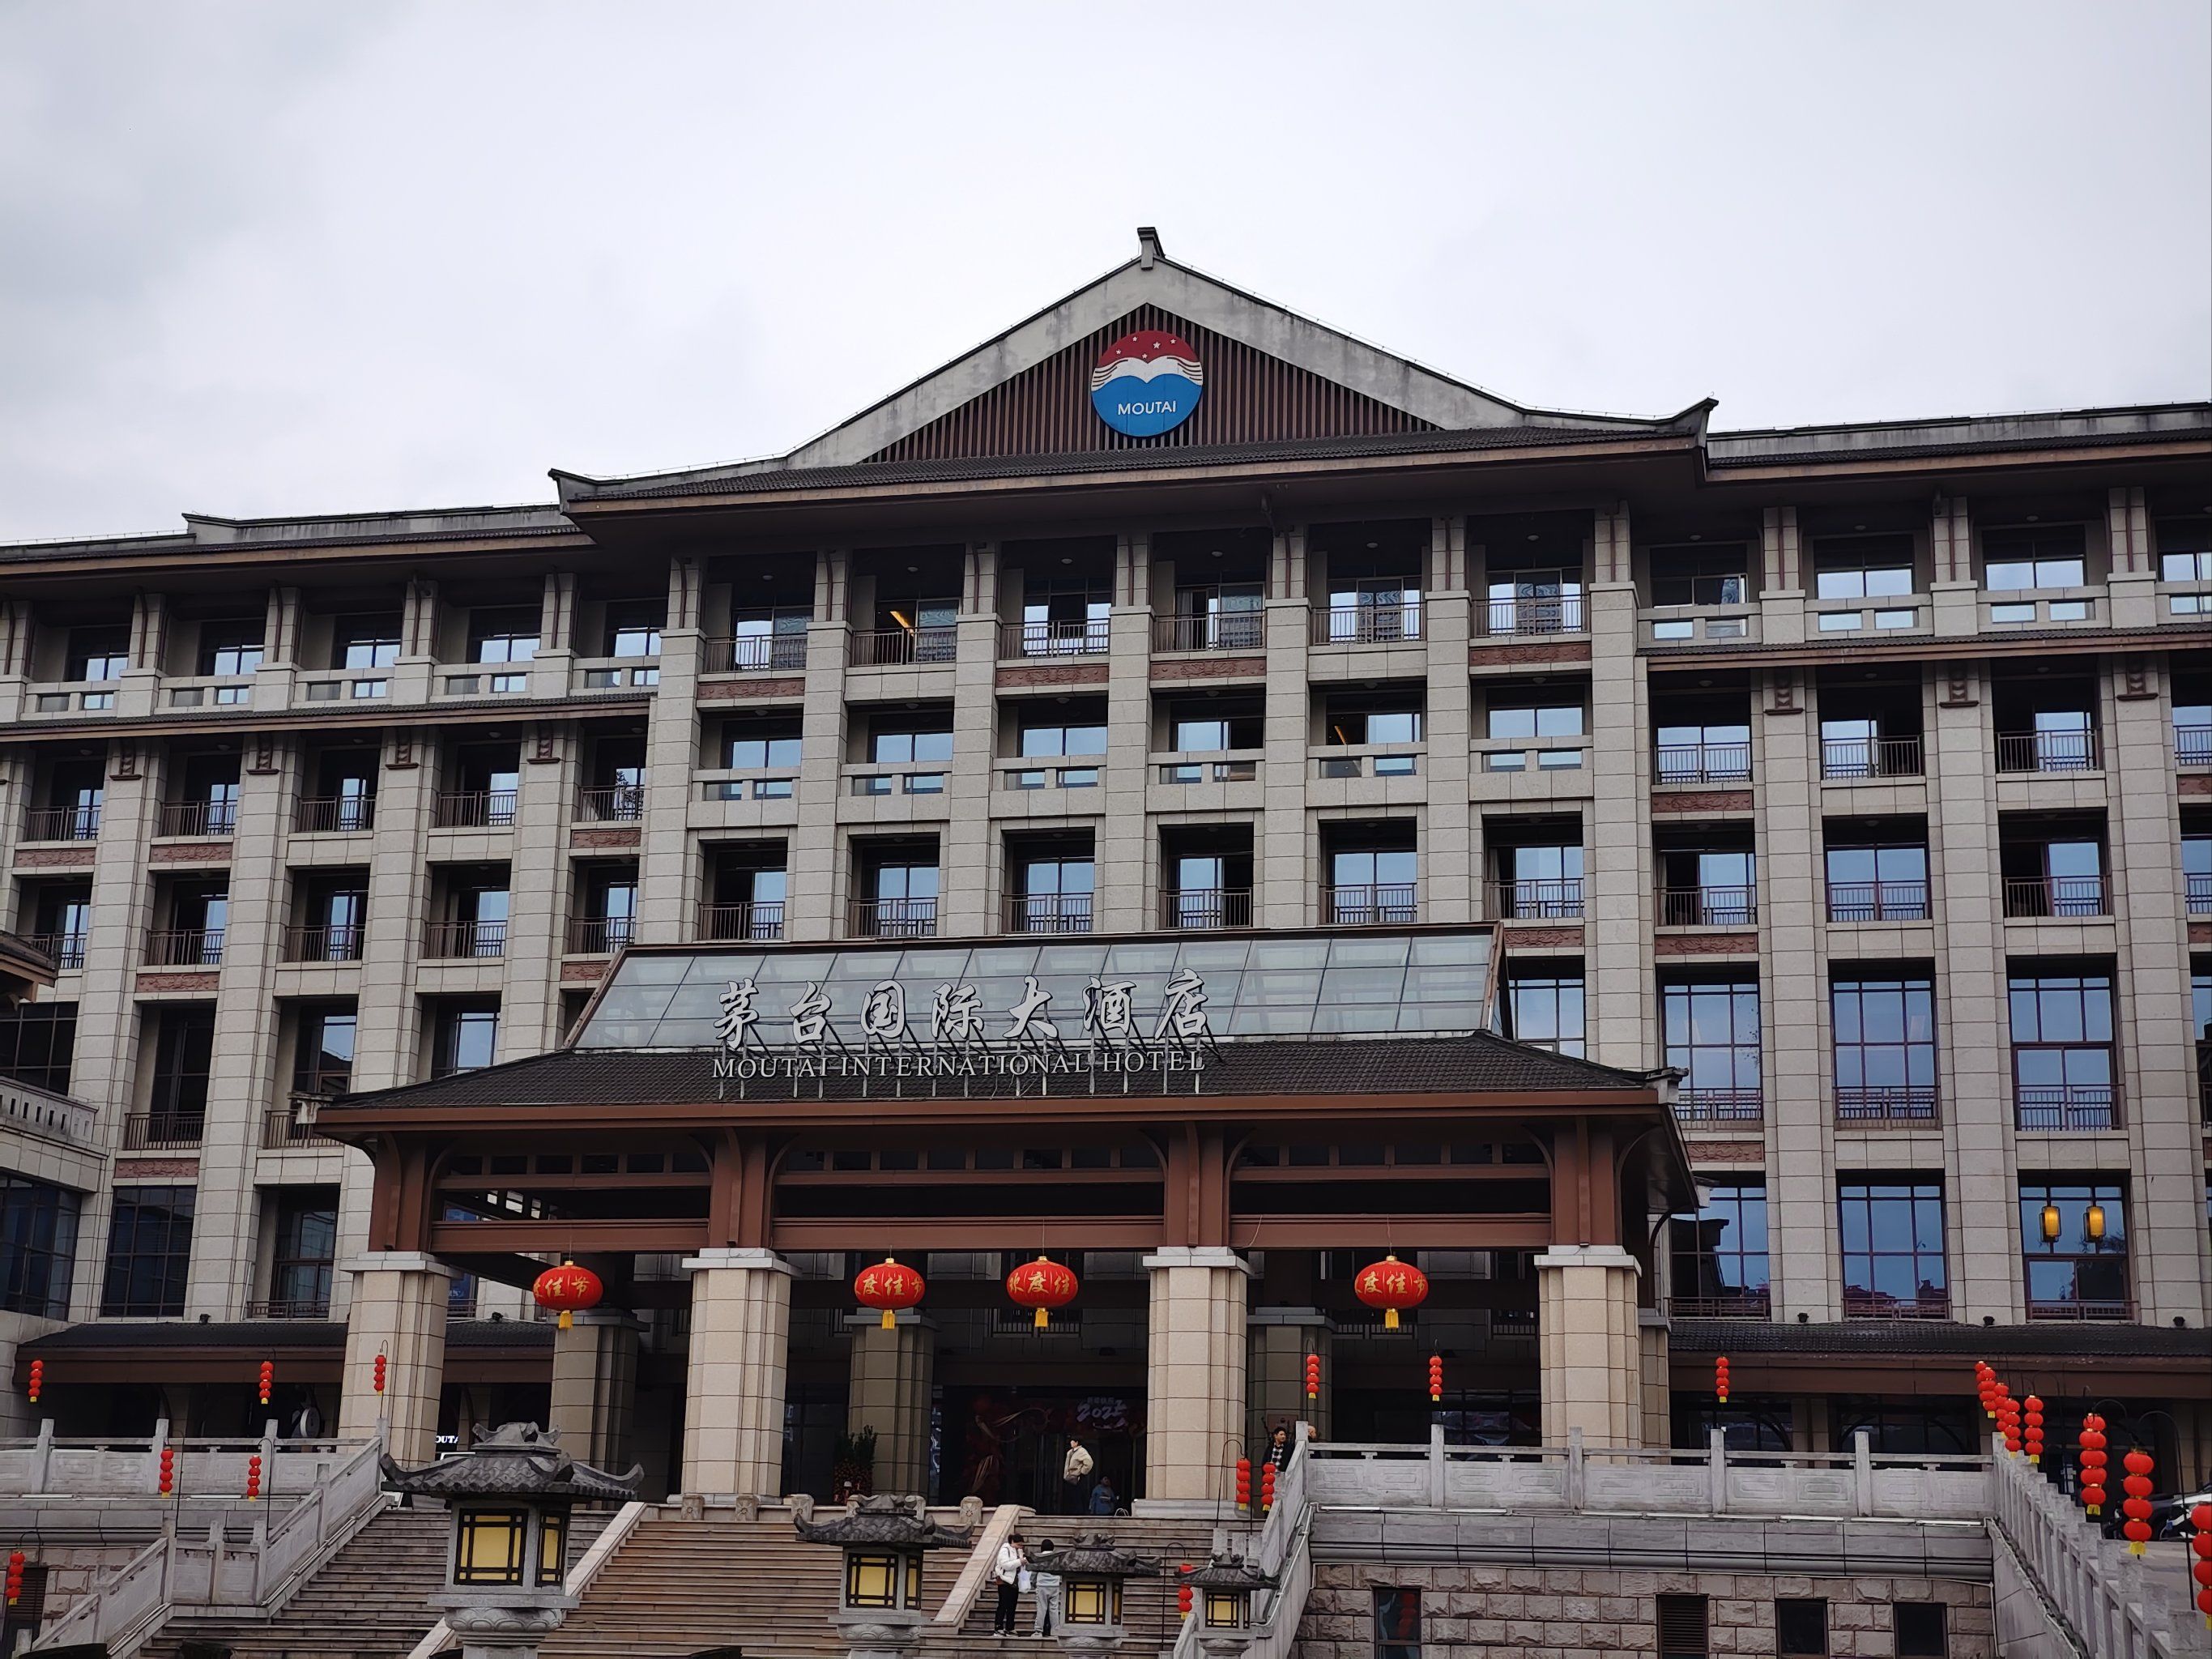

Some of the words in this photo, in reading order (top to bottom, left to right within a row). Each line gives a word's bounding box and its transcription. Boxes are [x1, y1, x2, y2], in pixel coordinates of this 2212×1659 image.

[1118, 400, 1177, 415] MOUTAI
[714, 968, 1209, 1051] 茅台国际大酒店
[712, 1056, 828, 1078] MOUTAI
[840, 1052, 1090, 1077] INTERNATIONAL
[1102, 1051, 1206, 1073] HOTEL
